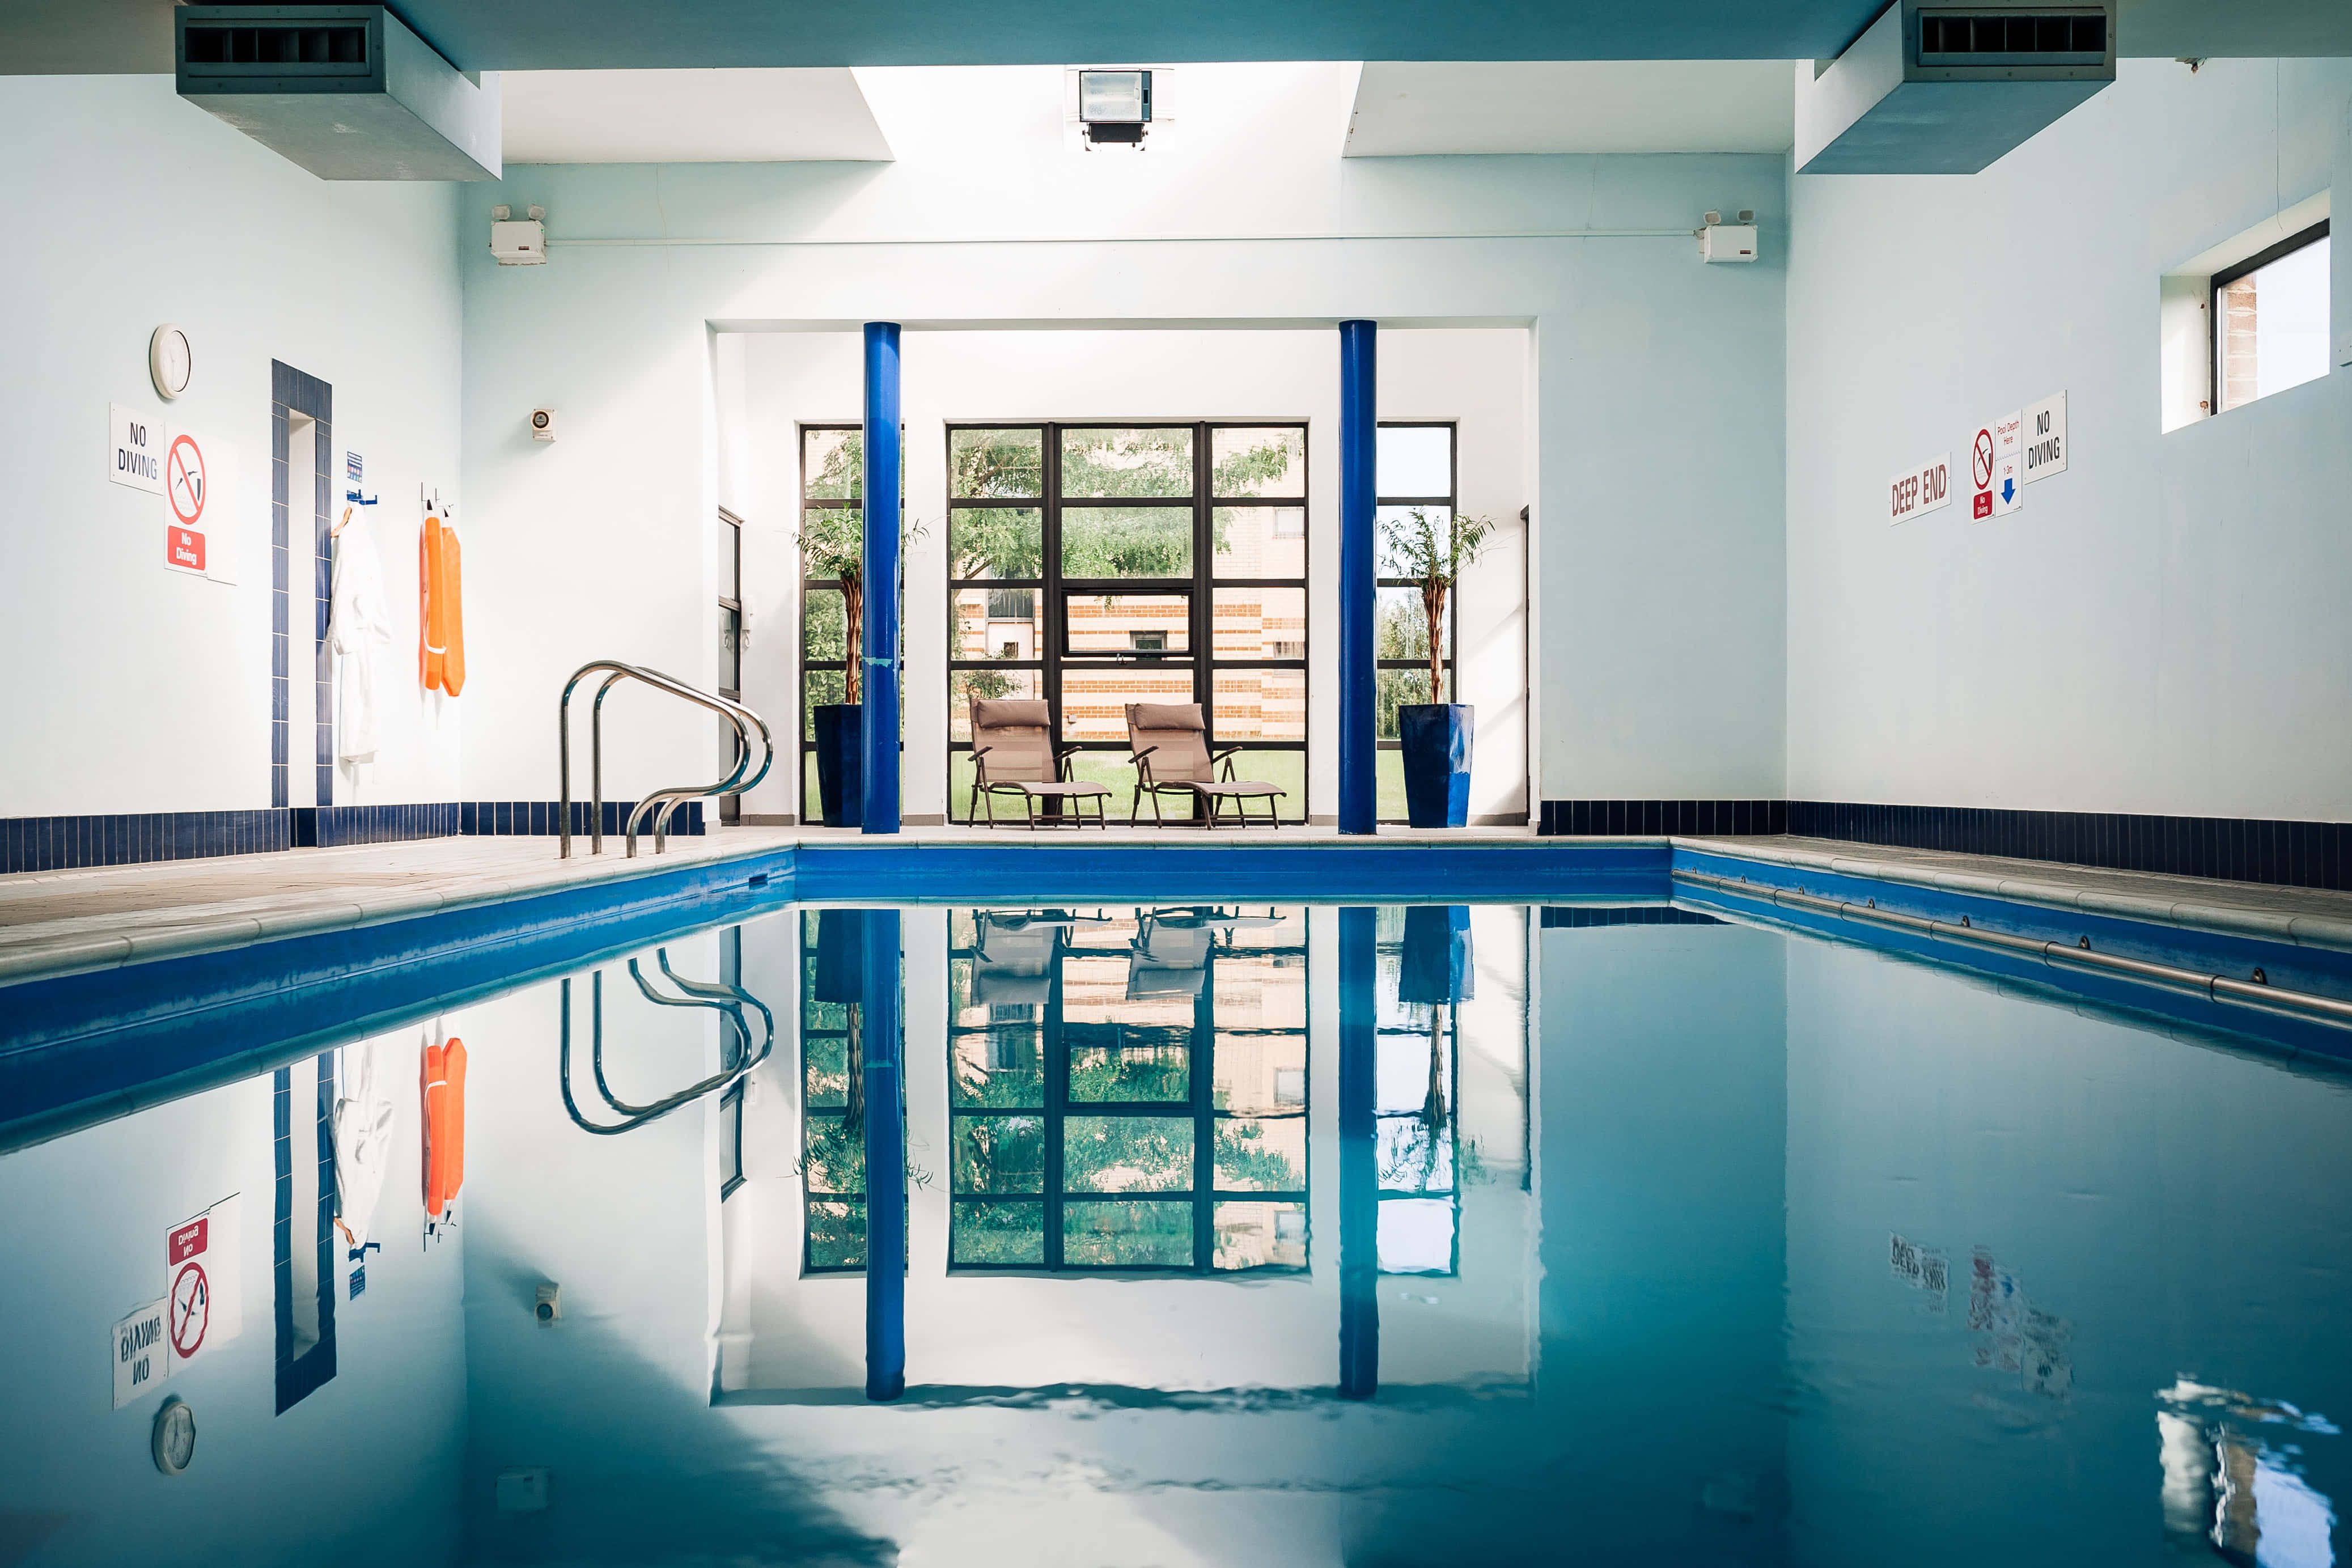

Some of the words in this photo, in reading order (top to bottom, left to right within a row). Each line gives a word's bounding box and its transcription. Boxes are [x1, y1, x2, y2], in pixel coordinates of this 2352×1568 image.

[130, 422, 147, 447] NO
[1998, 424, 2006, 435] Pool
[2007, 420, 2019, 432] Depth
[2037, 410, 2050, 436] NO
[2004, 436, 2013, 446] Here
[2028, 437, 2059, 469] DIVING
[118, 448, 157, 480] DIVING
[1892, 475, 1918, 517] DEEP
[1923, 464, 1947, 505] END
[181, 532, 192, 546] No
[176, 546, 197, 566] Diving
